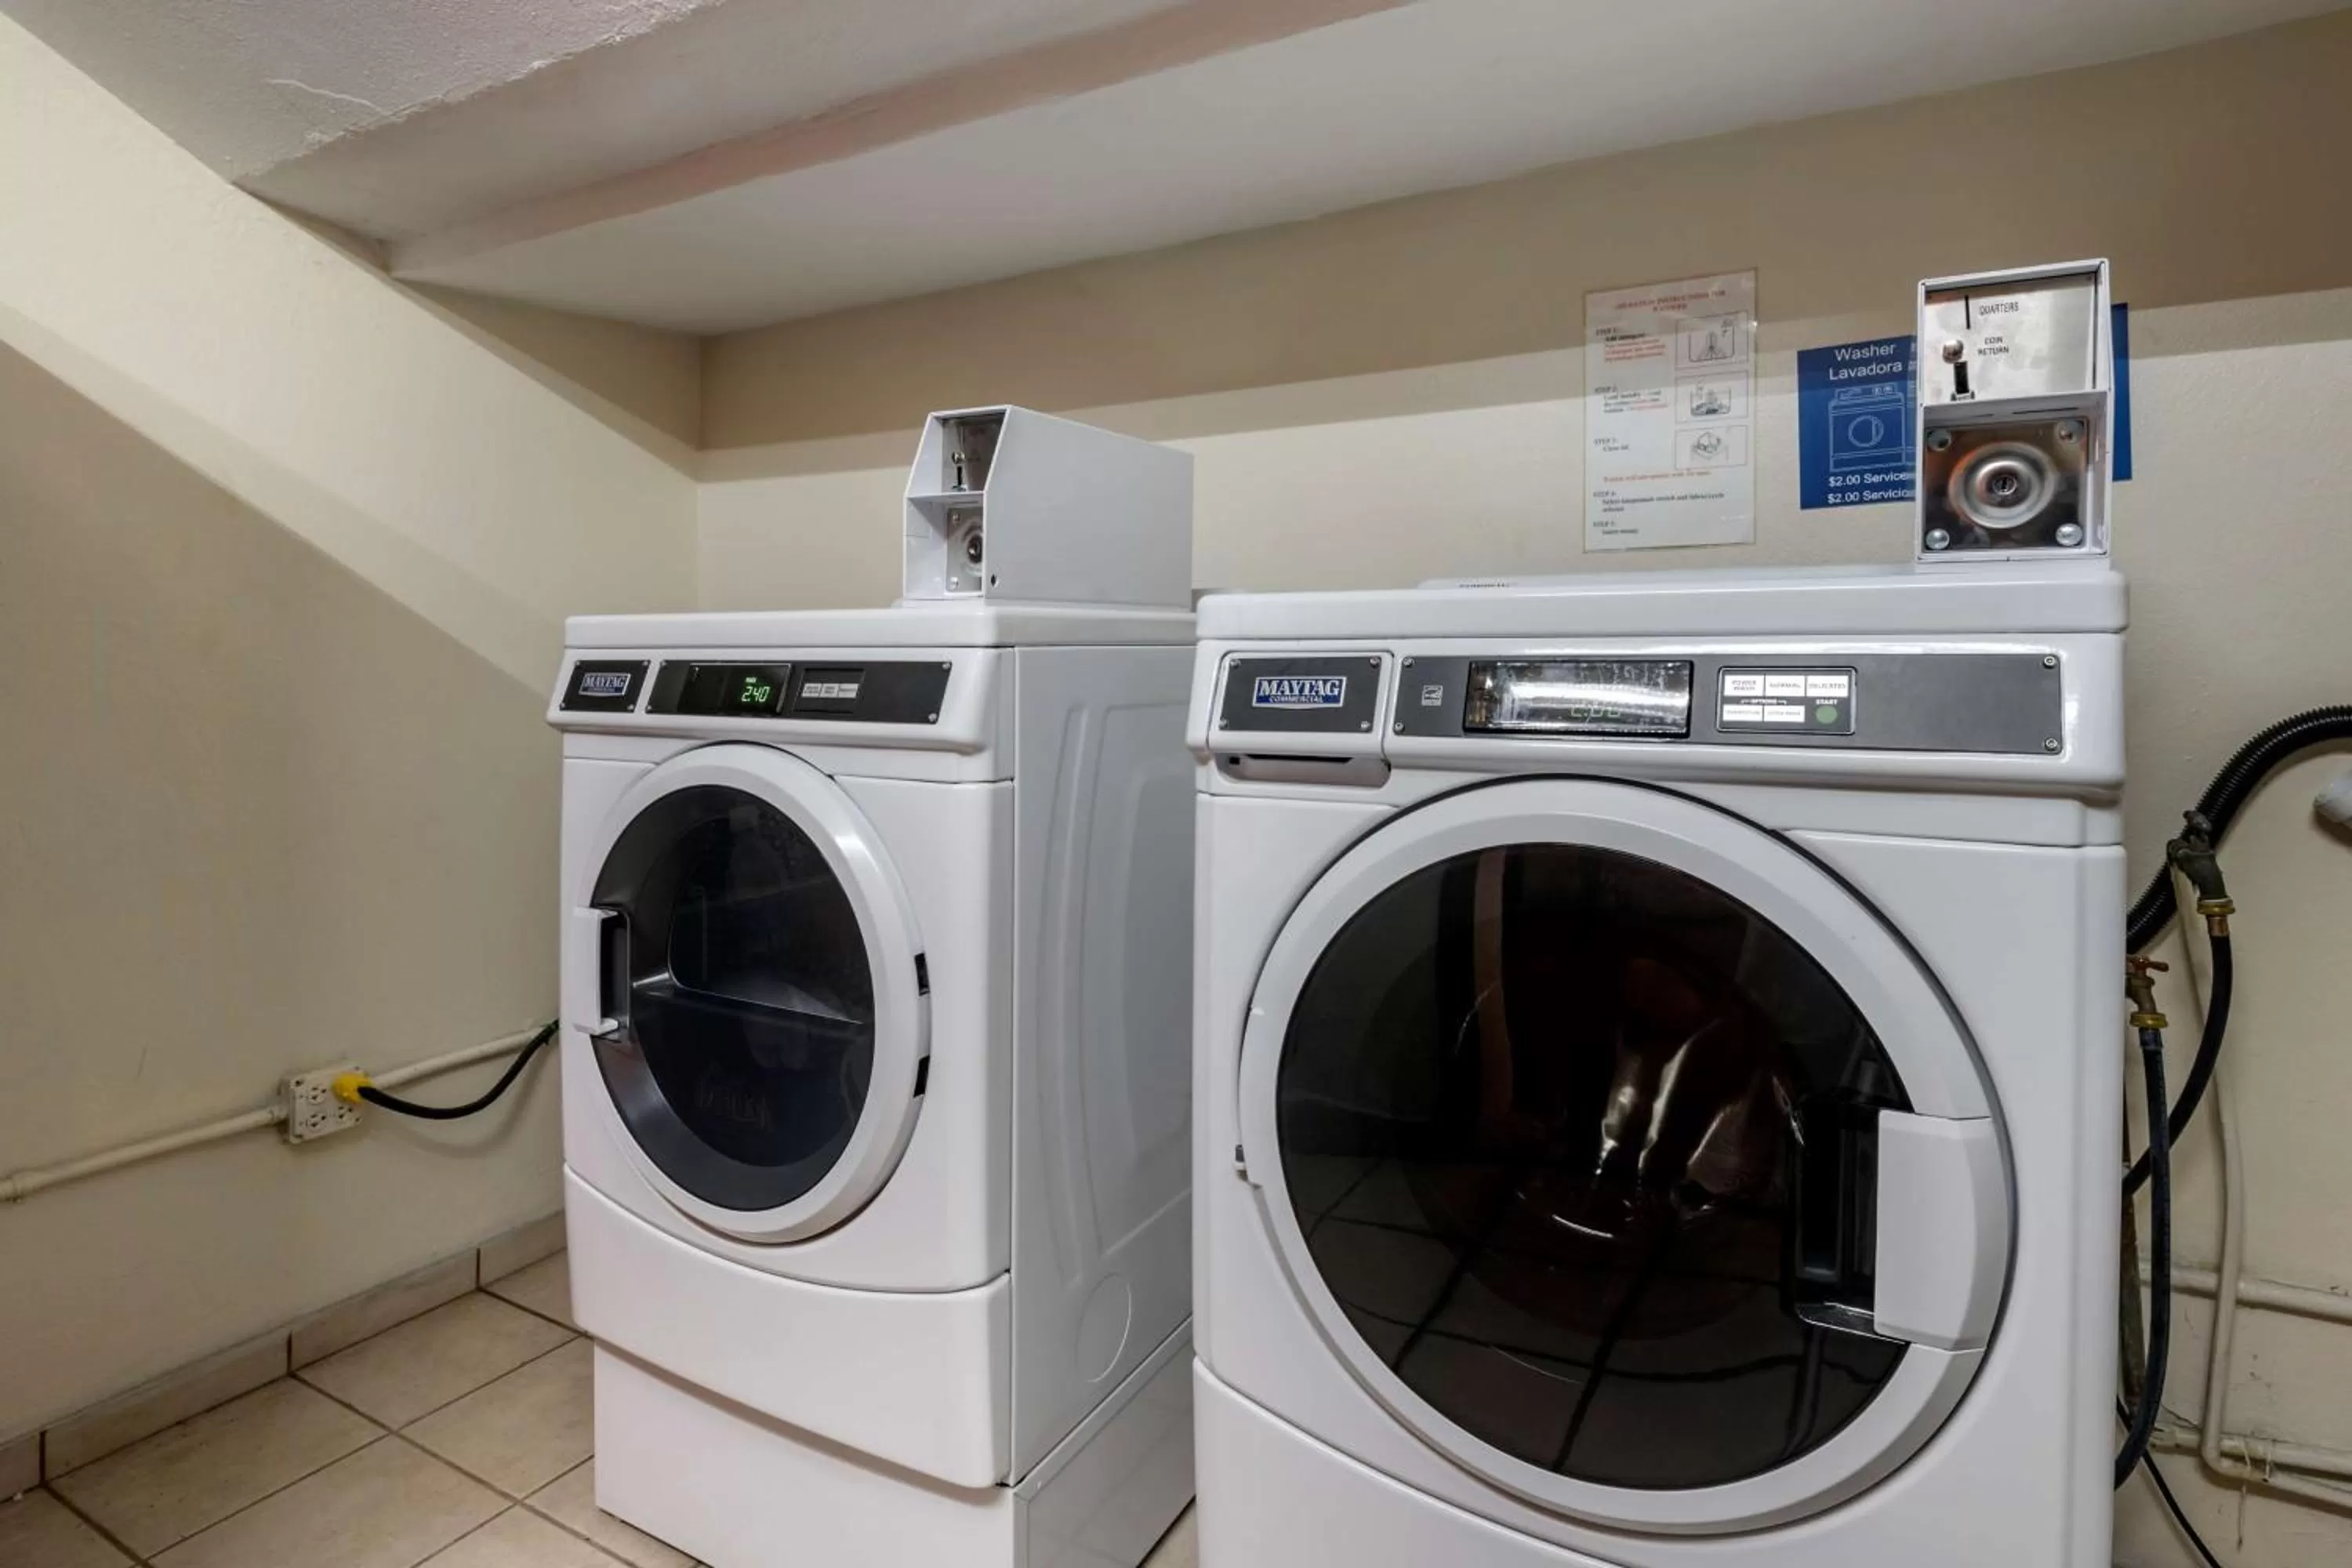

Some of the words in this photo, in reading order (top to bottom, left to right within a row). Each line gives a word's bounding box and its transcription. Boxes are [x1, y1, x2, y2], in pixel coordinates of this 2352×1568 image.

[1979, 302, 2020, 315] QUARTERS
[1984, 336, 2003, 345] COIN
[1835, 343, 1896, 361] Washer
[1977, 345, 2009, 355] RETURN
[1828, 361, 1903, 380] Lavadora
[1828, 474, 1860, 487] $2.00
[1864, 471, 1907, 484] Service
[1828, 492, 1860, 504] $2.00
[1863, 488, 1908, 500] Servicio
[583, 677, 625, 688] MAYTAG
[1258, 680, 1340, 696] MAYTAG
